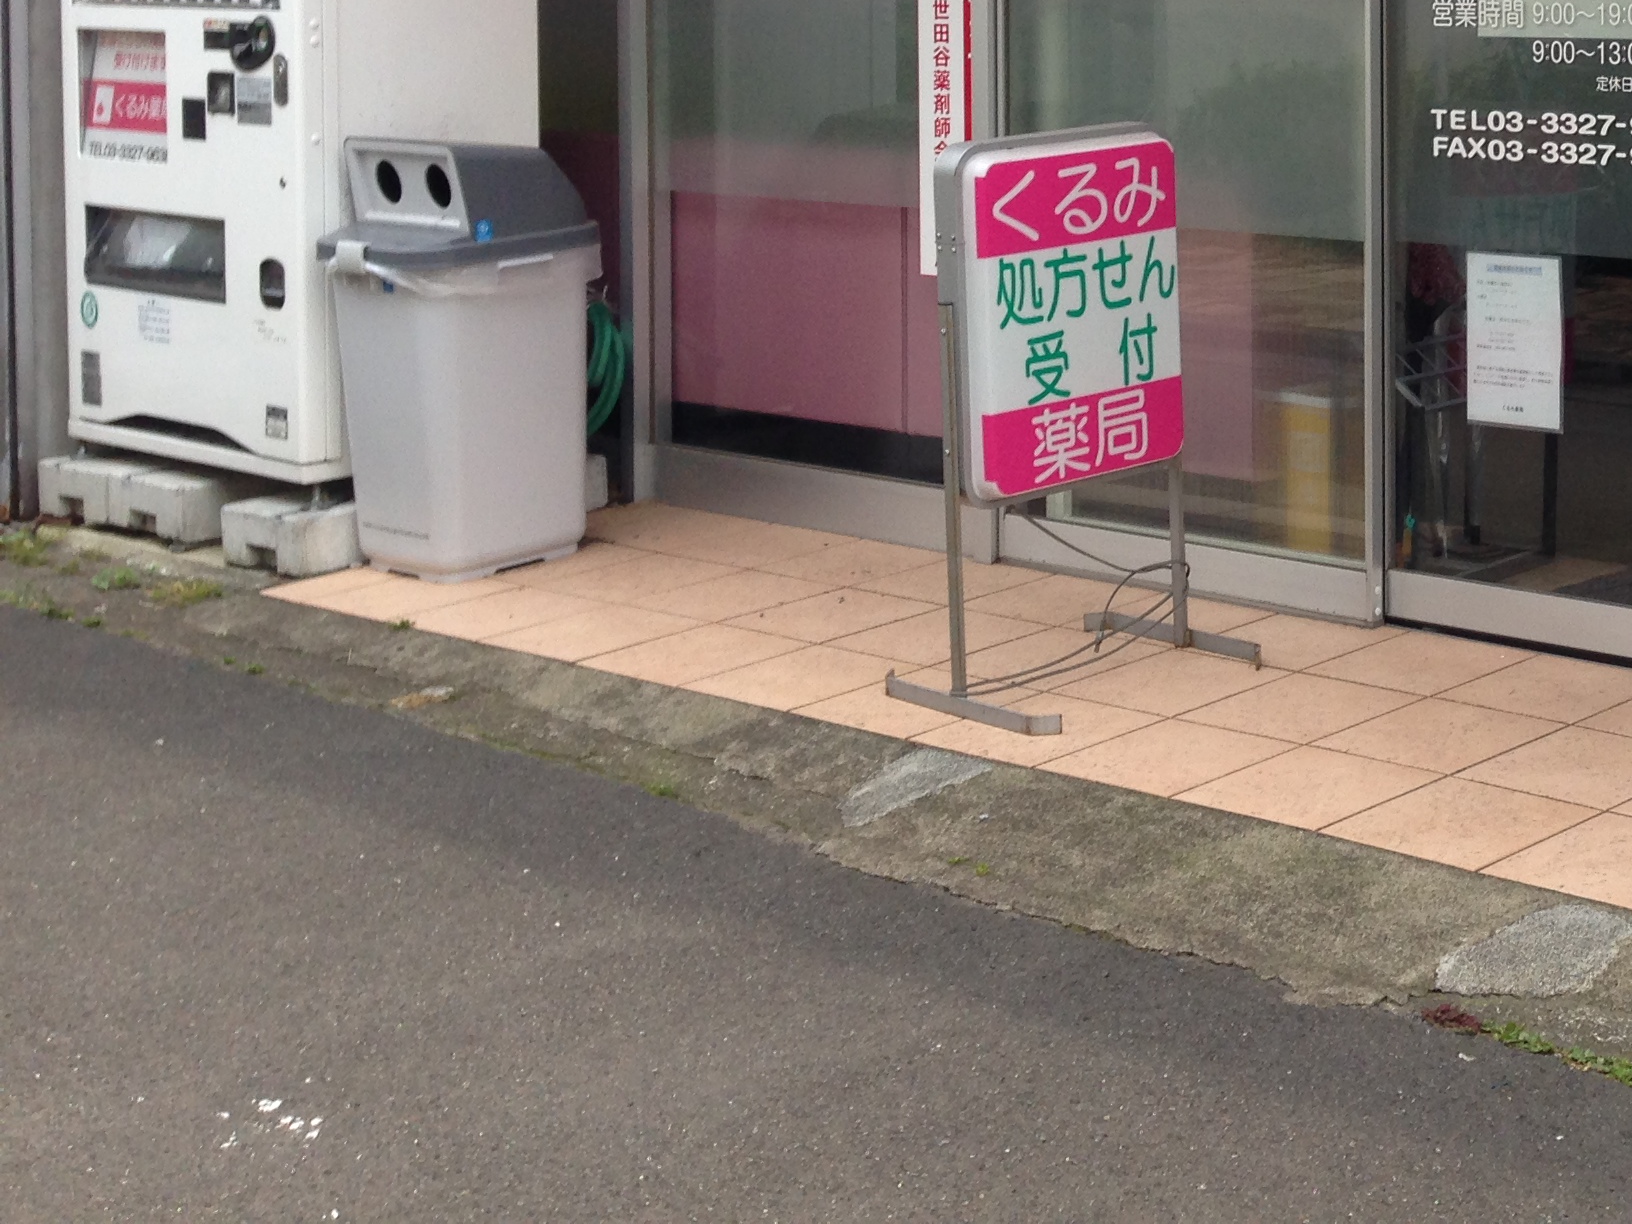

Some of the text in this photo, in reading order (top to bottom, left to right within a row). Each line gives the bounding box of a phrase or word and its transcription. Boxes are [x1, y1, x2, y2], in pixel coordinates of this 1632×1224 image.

[991, 157, 1166, 241] くるみ
[997, 236, 1175, 330] 処方せん
[1032, 388, 1149, 485] 薬局
